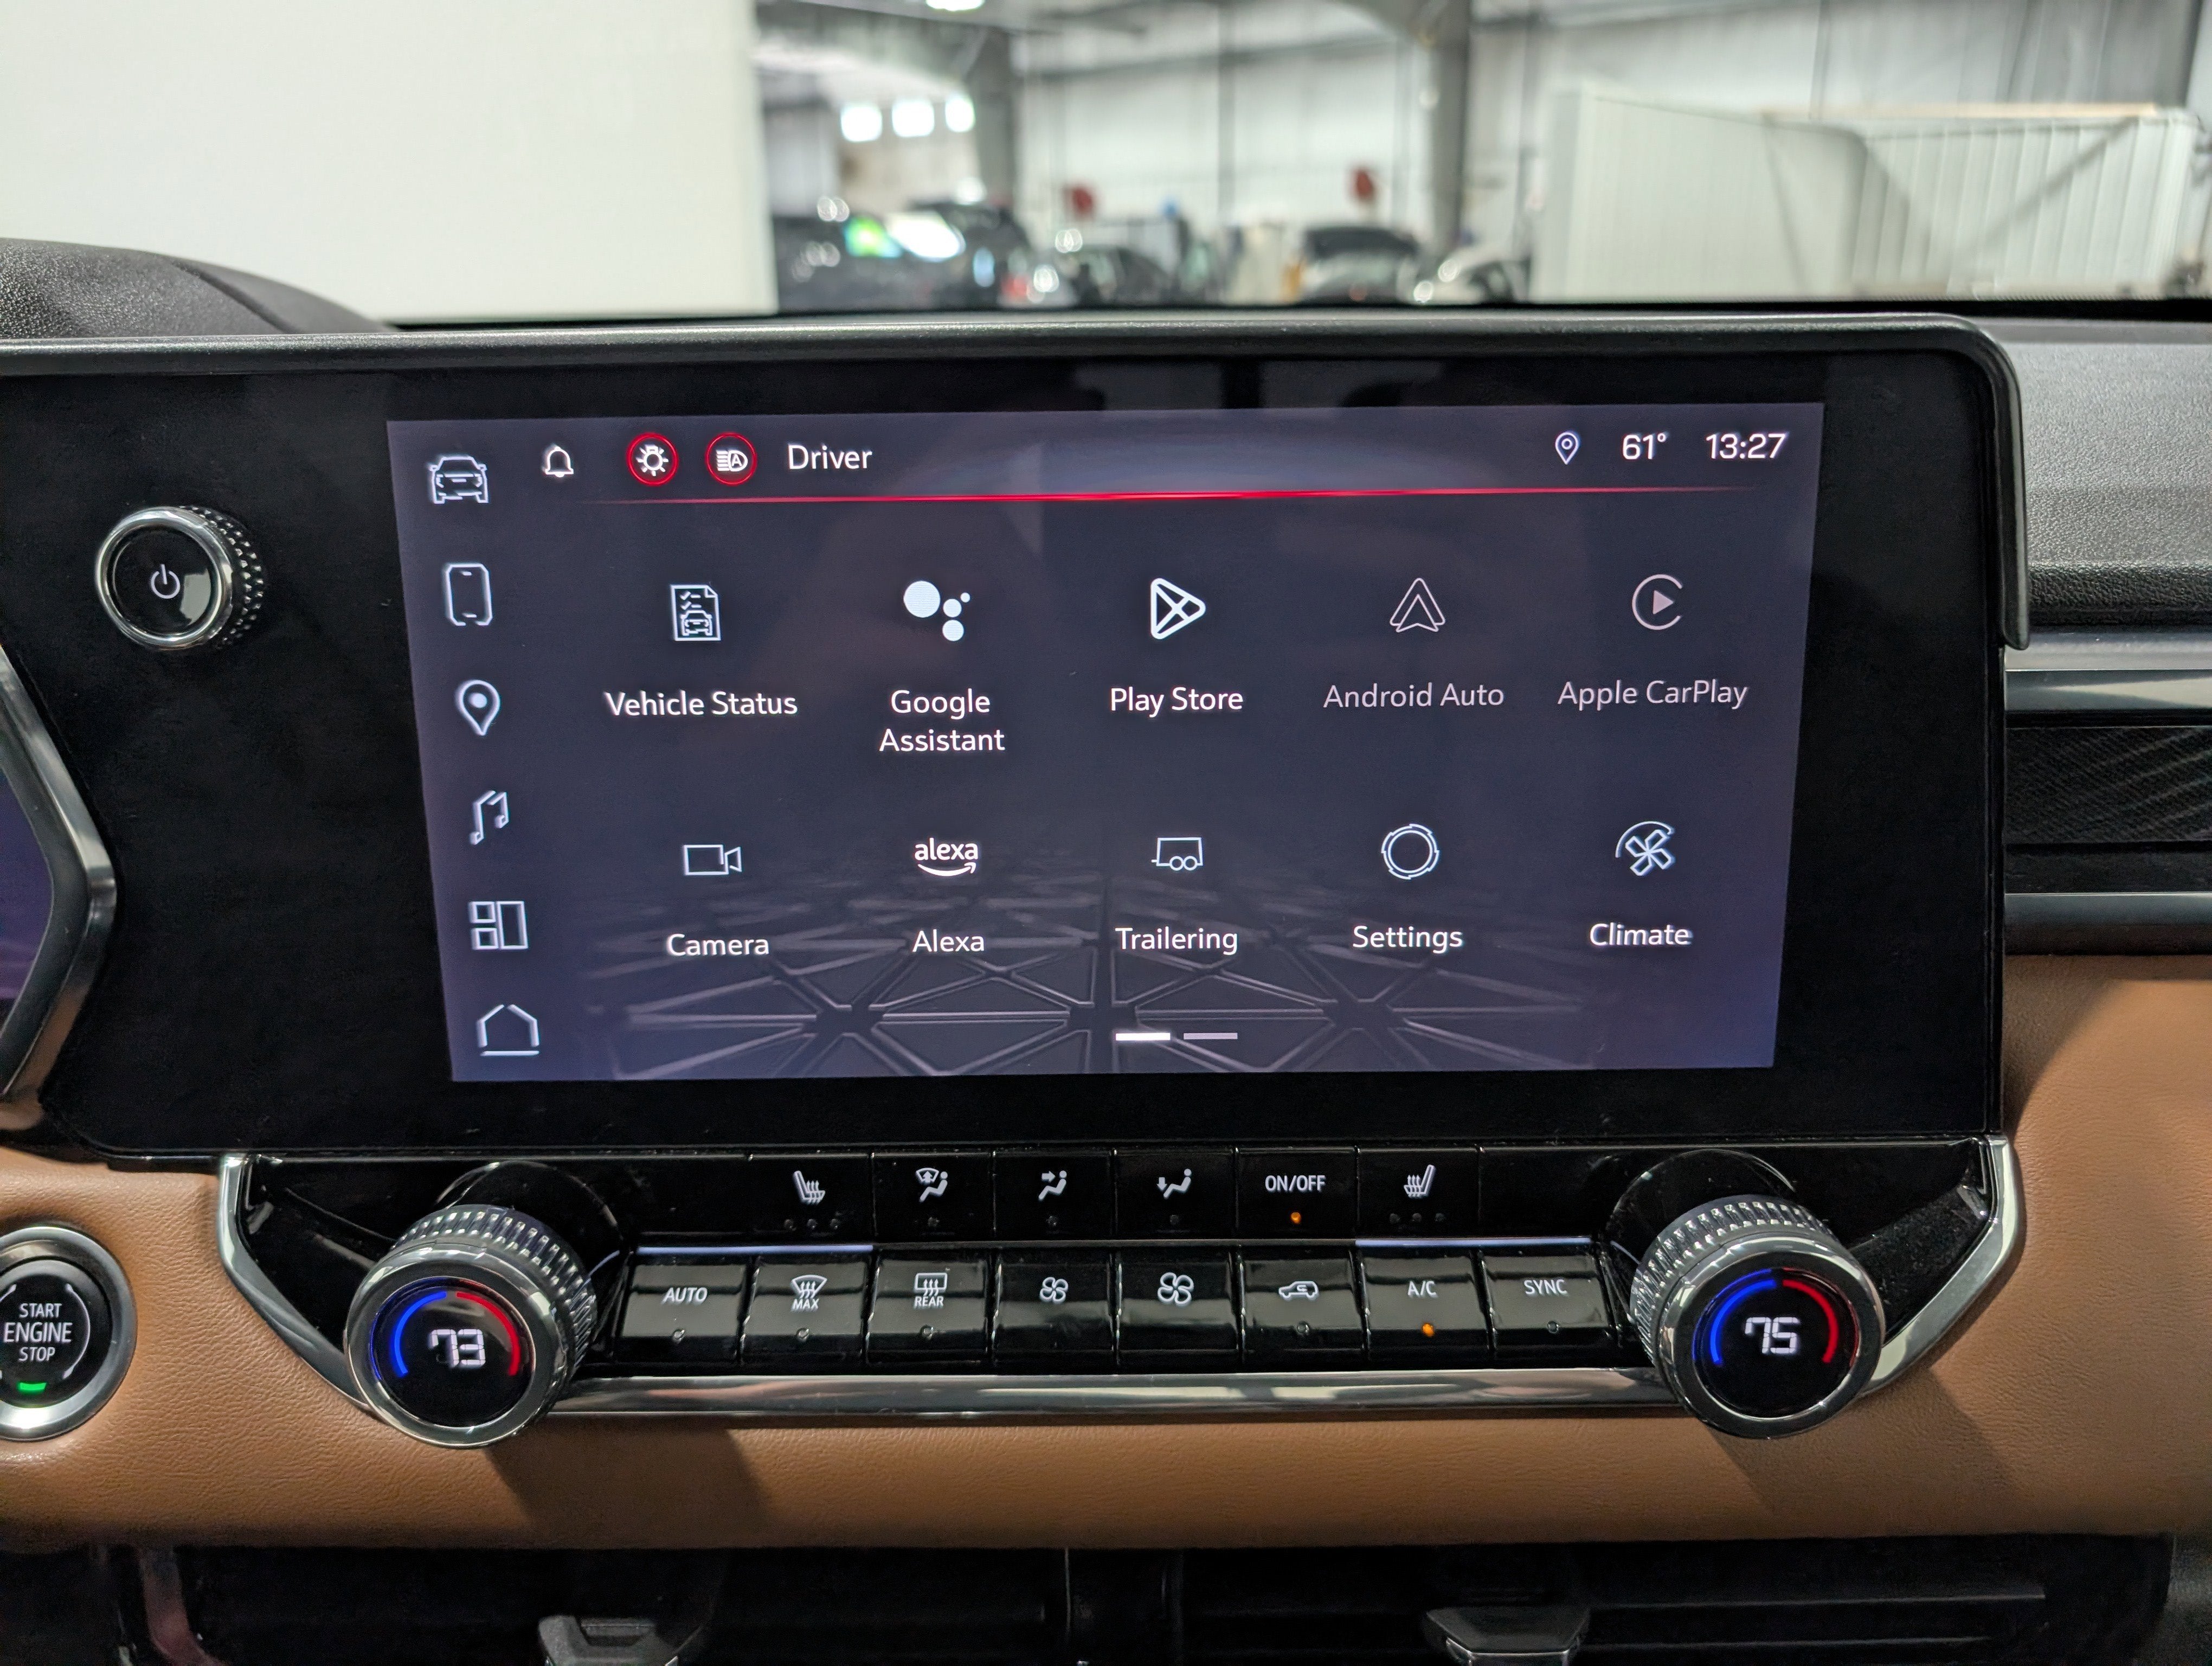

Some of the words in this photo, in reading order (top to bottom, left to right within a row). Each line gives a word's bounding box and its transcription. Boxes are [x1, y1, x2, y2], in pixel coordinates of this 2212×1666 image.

[788, 444, 873, 470] Driver
[1622, 432, 1667, 460] 61°
[1706, 432, 1787, 459] 13:27
[604, 689, 705, 716] Vehicle
[711, 690, 798, 715] Status
[891, 687, 991, 721] Google
[1110, 685, 1165, 719] Play
[1171, 686, 1244, 711] Store
[1322, 681, 1433, 708] Android
[1442, 682, 1504, 707] Auto
[1557, 679, 1638, 712] Apple
[1645, 678, 1748, 710] CarPlay
[878, 728, 1006, 752] Assistant
[914, 837, 979, 861] alexa
[666, 933, 770, 957] Camera
[912, 928, 985, 953] Alexa
[1114, 925, 1238, 956] Trailering
[1352, 925, 1463, 954] Settings
[1589, 921, 1692, 947] Climate
[1264, 1174, 1326, 1192] ON/OFF
[662, 1286, 708, 1304] AUTO
[1407, 1280, 1437, 1298] A/C
[1523, 1278, 1568, 1295] SYNC
[19, 1302, 63, 1318] START
[792, 1296, 820, 1310] MAX
[914, 1294, 944, 1308] REAR
[3, 1321, 73, 1343] ENGINE
[1744, 1316, 1801, 1355] 75
[18, 1346, 56, 1362] STOP
[430, 1328, 486, 1367] 73
